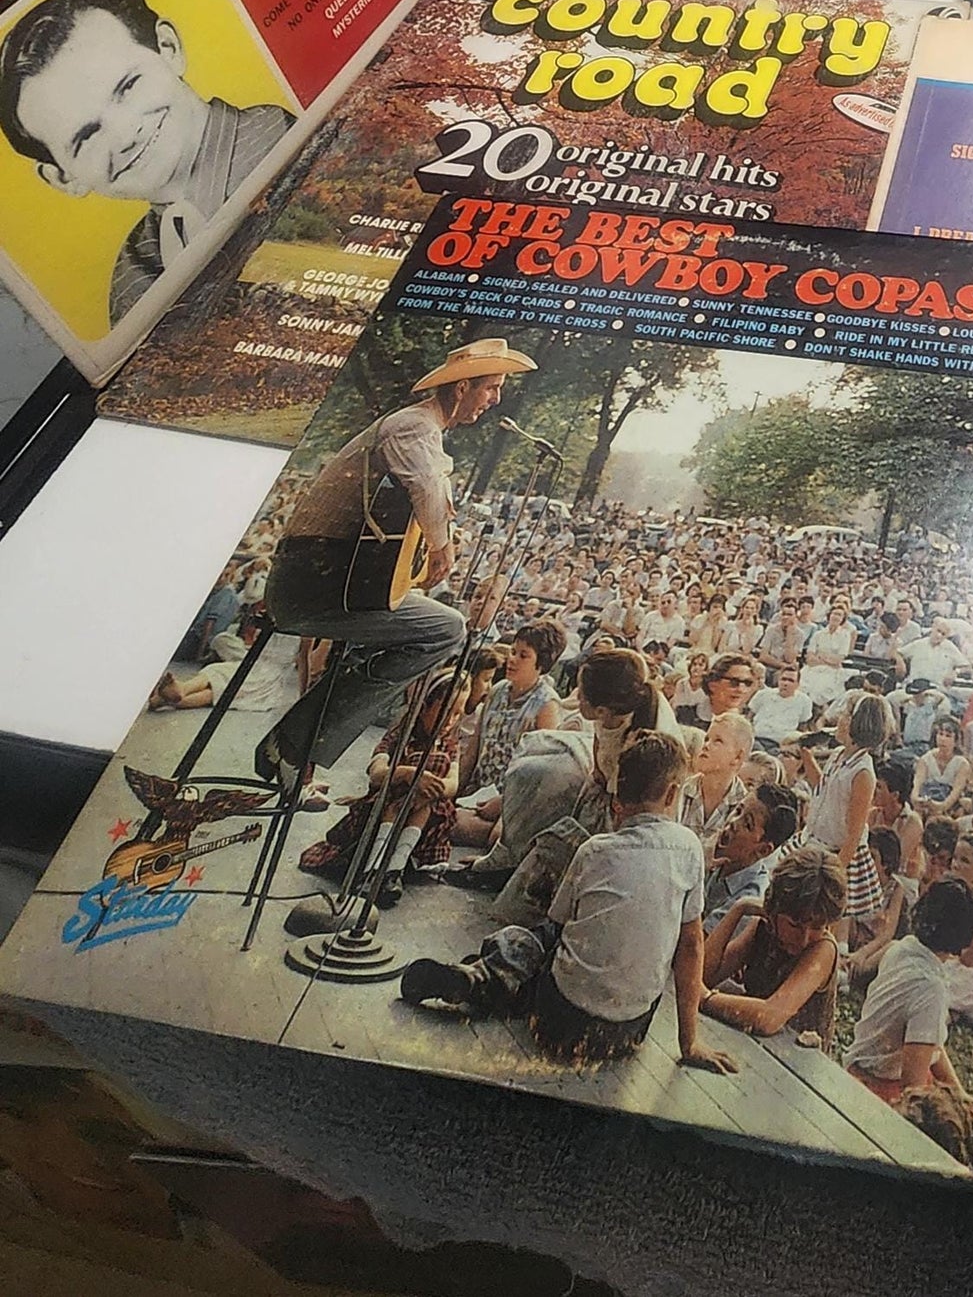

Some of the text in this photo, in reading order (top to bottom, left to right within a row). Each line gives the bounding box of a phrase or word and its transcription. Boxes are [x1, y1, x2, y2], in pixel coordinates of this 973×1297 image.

[518, 48, 783, 124] road
[849, 100, 890, 127] advertised
[429, 120, 553, 182] 20
[556, 140, 779, 187] original hits
[525, 169, 773, 221] original stars
[348, 213, 410, 232] CHARLIE
[449, 197, 735, 258] THE BEST
[298, 281, 357, 300] TAMMY
[303, 268, 366, 288] GEORGE
[426, 230, 511, 269] OF
[515, 240, 789, 300] COWBOY
[277, 313, 333, 332] SONNY
[404, 283, 467, 301] COWBOY'S
[468, 289, 503, 303] DECK
[504, 293, 521, 305] OF
[521, 295, 562, 310] CARDS
[579, 302, 624, 317] TRAGIC
[626, 307, 689, 325] ROMANCE
[711, 317, 767, 333] FILIPINO
[769, 322, 806, 337] BABY
[834, 330, 869, 345] RIDE
[869, 334, 884, 346] IN
[886, 336, 909, 349] MY
[910, 339, 960, 354] LITTLE
[413, 269, 466, 284] ALABAM
[482, 275, 531, 292] SIGNED,
[531, 281, 579, 297] SEALED
[580, 286, 609, 300] AND
[609, 290, 678, 307] DELIVERED
[693, 299, 737, 314] SUNNY
[738, 304, 814, 322] TENNESSEE
[826, 313, 888, 330] GOODBYE
[890, 319, 936, 335] KISSES
[233, 340, 304, 363] BARBARA
[397, 296, 432, 311] FROM
[436, 301, 462, 314] THE
[462, 304, 518, 321] MANGER
[520, 308, 537, 321] TO
[538, 311, 564, 325] THE
[565, 314, 609, 330] CROSS
[634, 323, 678, 338] SOUTH
[680, 327, 730, 343] PACIFIC
[731, 332, 776, 349] SHORE
[804, 342, 846, 357] DON'T
[848, 347, 895, 363] SHAKE
[895, 353, 940, 369] HANDS
